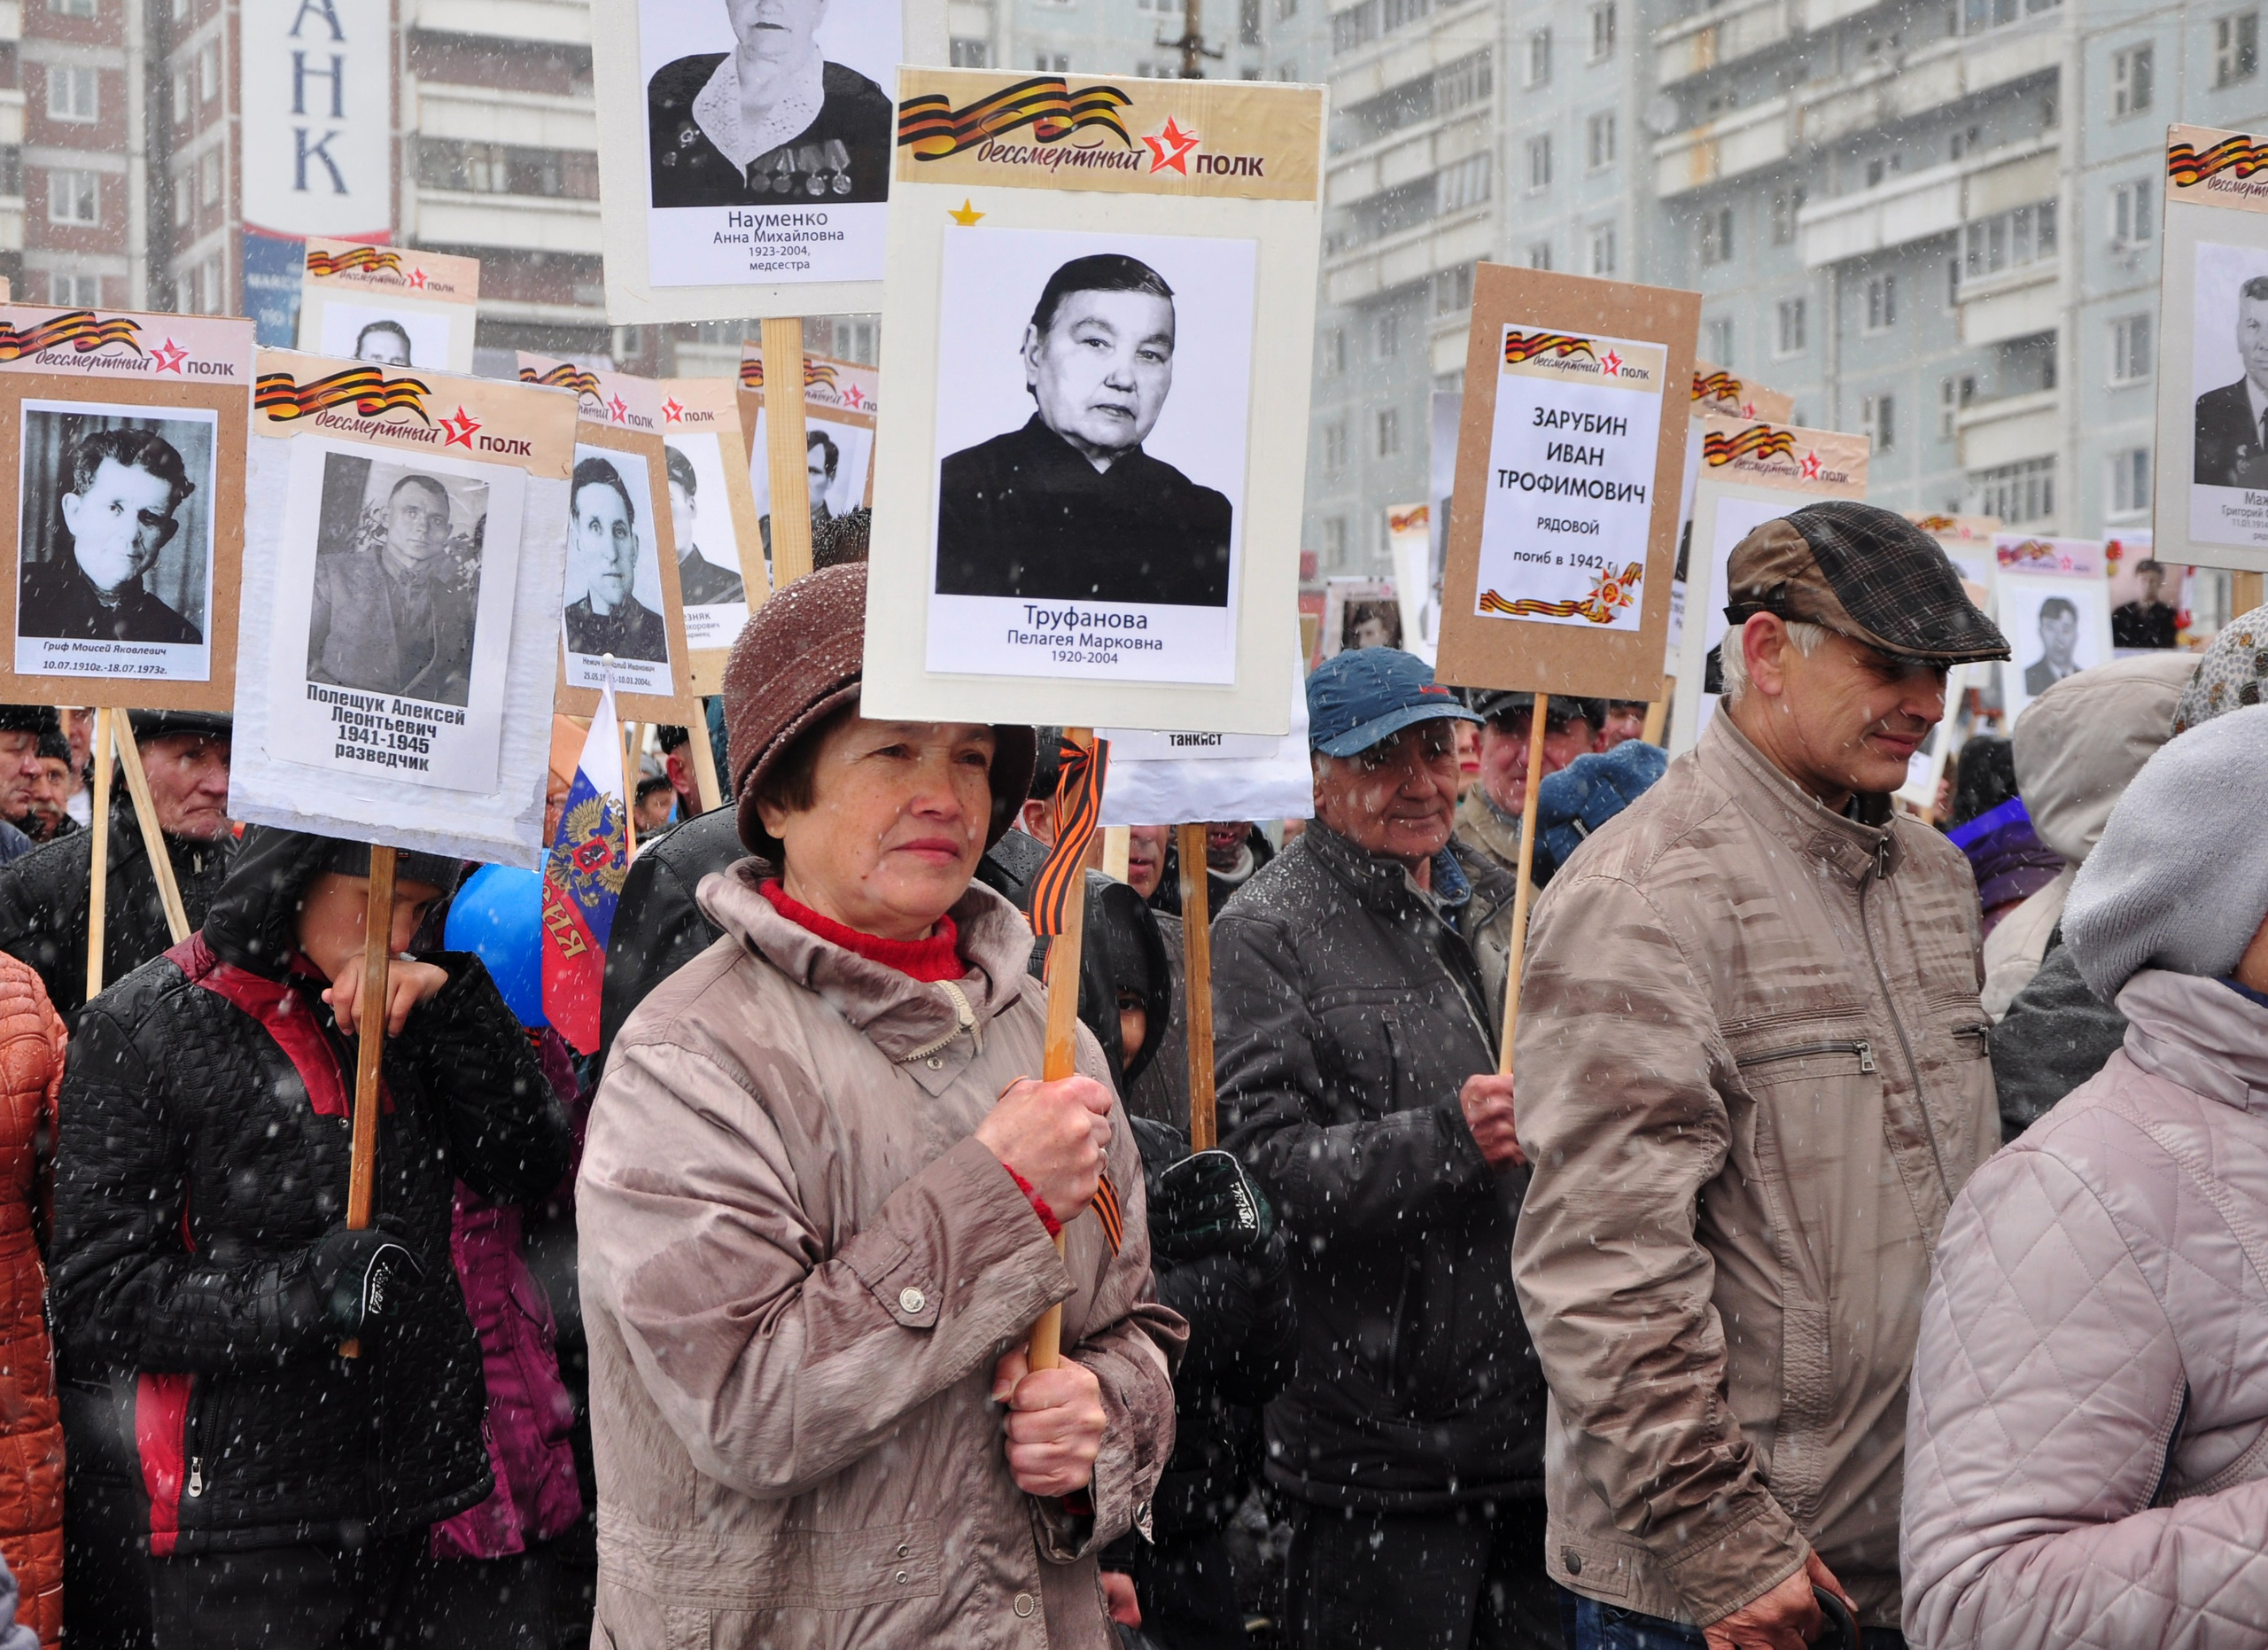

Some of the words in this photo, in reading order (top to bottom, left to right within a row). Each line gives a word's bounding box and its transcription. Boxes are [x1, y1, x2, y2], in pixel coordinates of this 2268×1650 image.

[977, 128, 1146, 174] бессмертный
[2208, 167, 2268, 198] бессмерт
[728, 211, 828, 231] Науменко
[713, 232, 750, 244] Анна
[754, 230, 844, 243] Михайловна
[749, 245, 811, 257] 1923-2004,
[750, 261, 810, 272] медсестра
[35, 341, 152, 372] бессмертный
[1534, 354, 1602, 373] бессмертный
[315, 401, 441, 443] бессмертный
[1533, 407, 1627, 436] ЗАРУБИН
[1547, 441, 1604, 467] ИВАН
[1498, 469, 1645, 504] ТРОФИМОВИЧ
[2222, 504, 2264, 518] Григорий
[1537, 517, 1600, 535] РЯДОВОЙ
[1513, 550, 1552, 564] погиб
[1556, 556, 1564, 565] в
[1569, 553, 1604, 570] 1942
[1023, 604, 1148, 631] Труфанова
[43, 642, 69, 652] Гриф
[72, 642, 111, 653] Моисей
[113, 644, 167, 656] Яковлевич
[1007, 630, 1074, 646] Пелагея
[1079, 633, 1163, 651] Марковна
[627, 662, 655, 672] Иванович
[1051, 650, 1119, 664] 1920-2004
[307, 684, 384, 712] Полещук
[391, 698, 465, 726] Алексей
[331, 706, 437, 738] Леонтьевич
[338, 725, 430, 754] 1941-1945
[1169, 734, 1223, 746] танкист
[335, 743, 430, 772] разведчик
